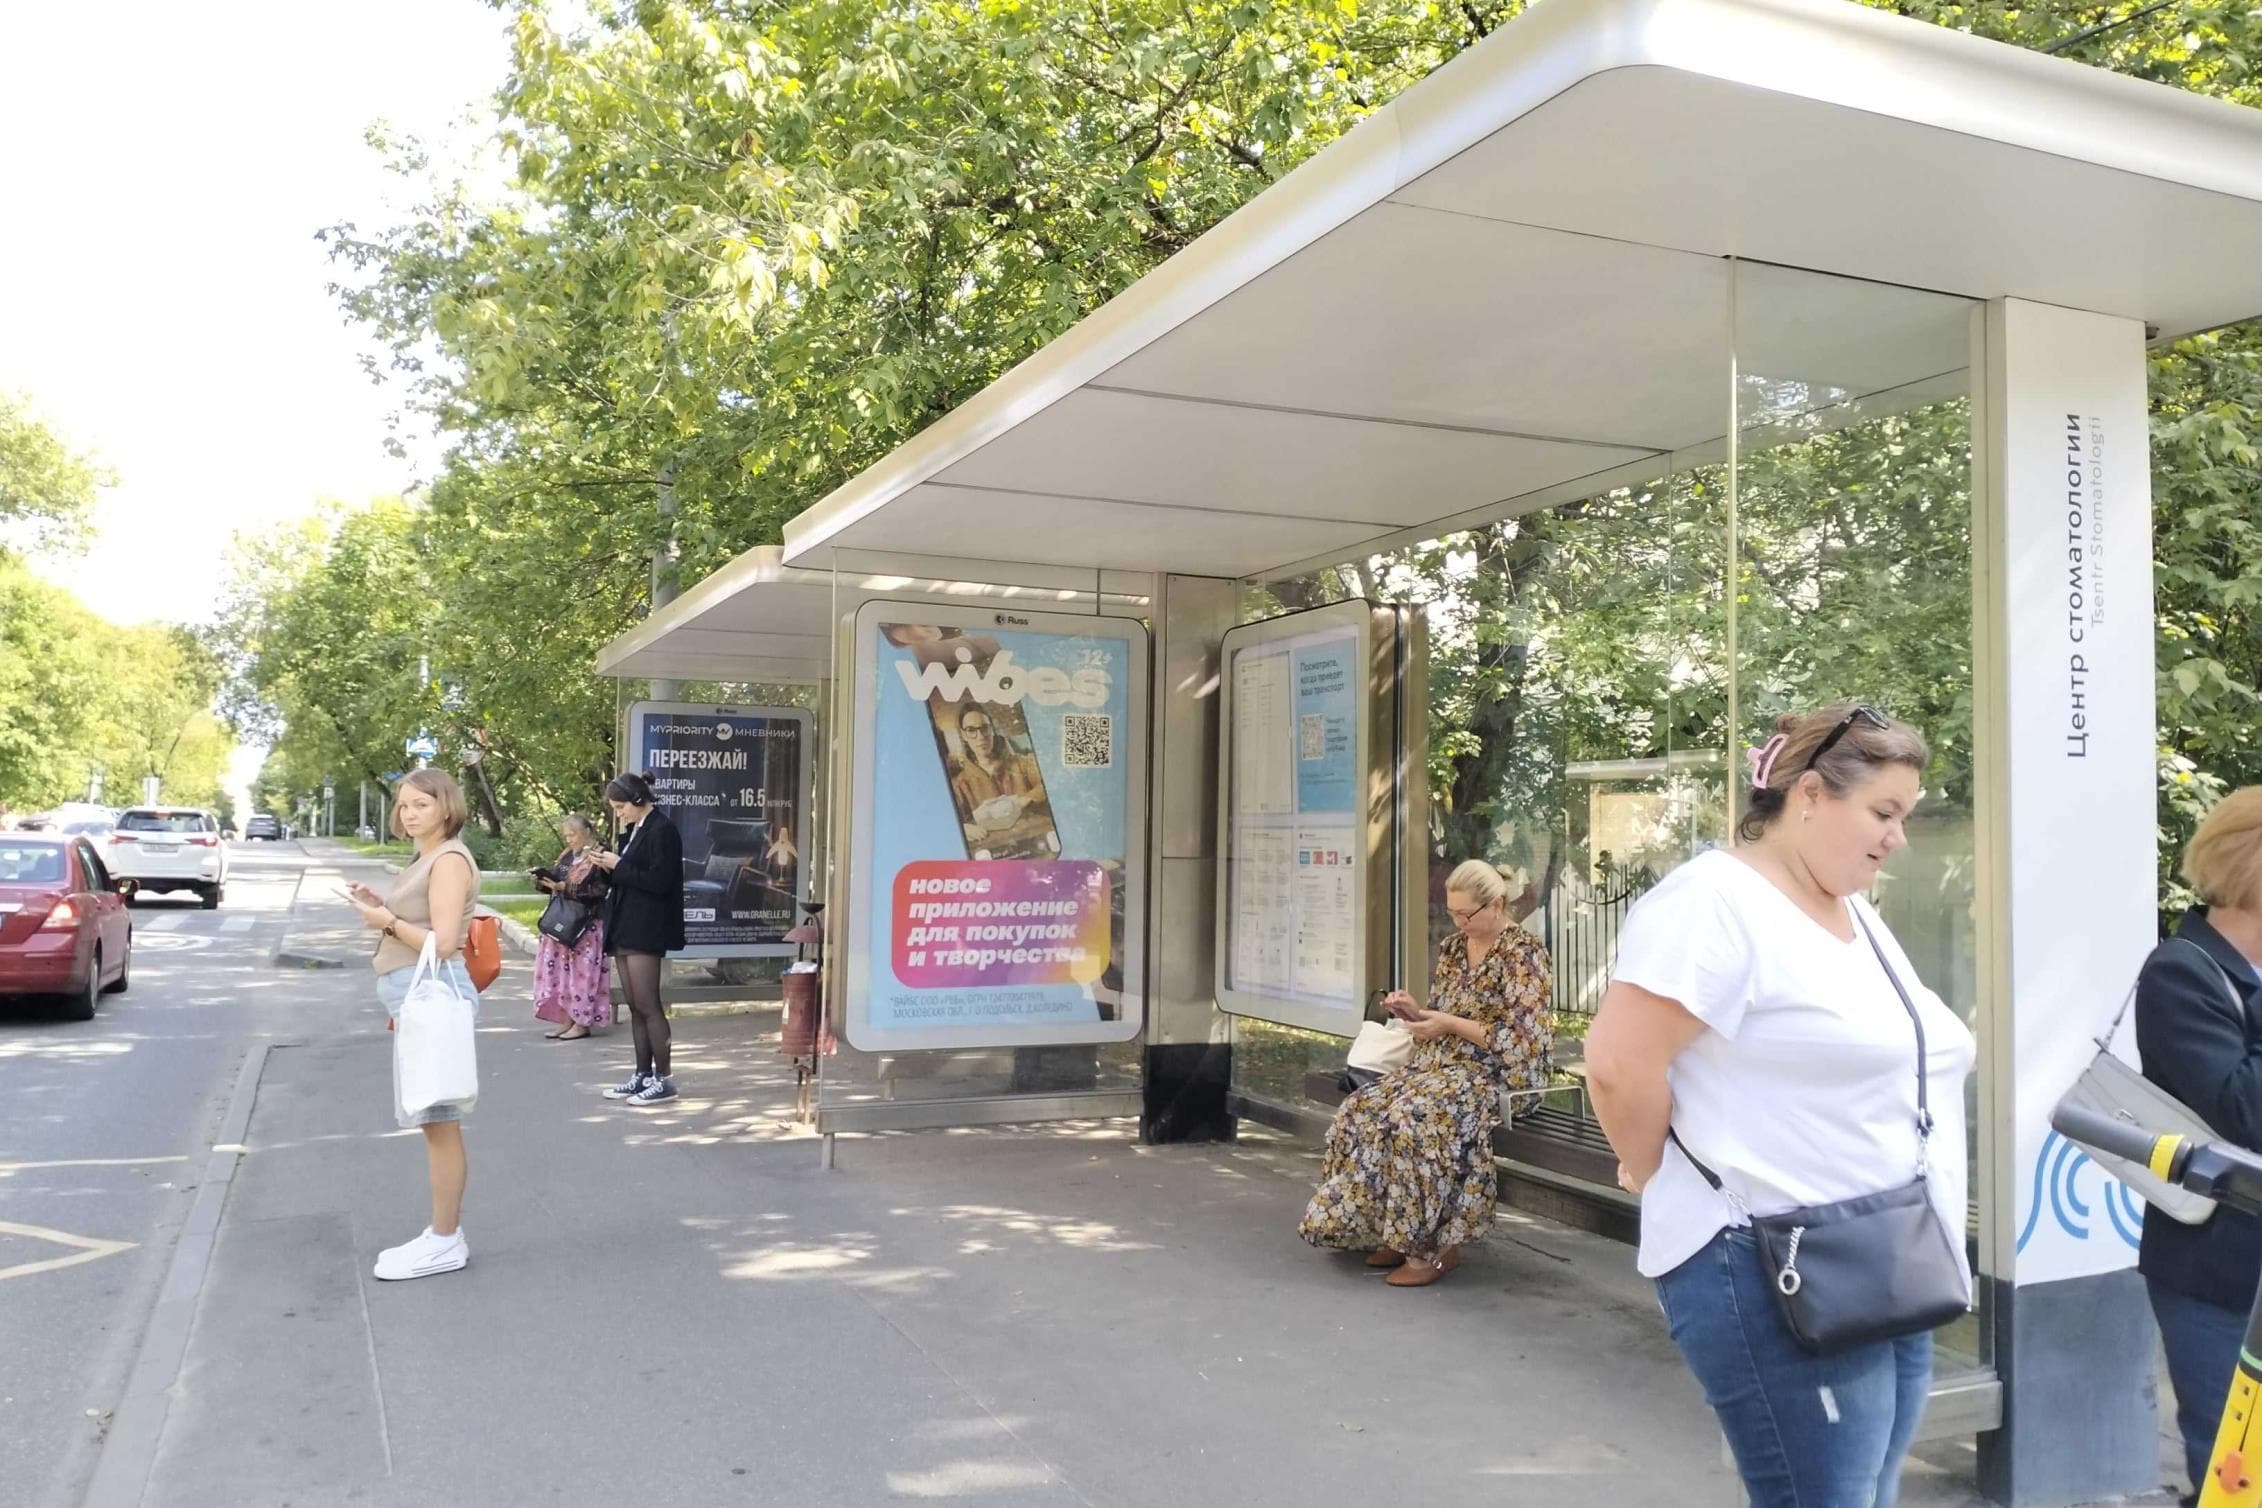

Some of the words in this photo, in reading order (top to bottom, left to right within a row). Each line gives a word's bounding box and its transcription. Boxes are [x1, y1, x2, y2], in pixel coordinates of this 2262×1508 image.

[2089, 416, 2104, 557] Stomatologii
[2066, 414, 2084, 643] стоматологии
[2091, 562, 2104, 628] Tsentr
[1007, 616, 1029, 625] Russ
[2067, 654, 2090, 757] Центр
[735, 728, 795, 737] МНЕВНИКИ
[650, 748, 747, 770] ПЕРЕЕЗЖАЙ!
[652, 793, 720, 806] ИЗНЕС-КЛАССА
[739, 787, 766, 807] 16.5
[909, 878, 992, 894] новое
[908, 901, 1079, 924] приложение
[906, 926, 960, 946] для
[966, 923, 1078, 946] покупок
[907, 951, 927, 967] и
